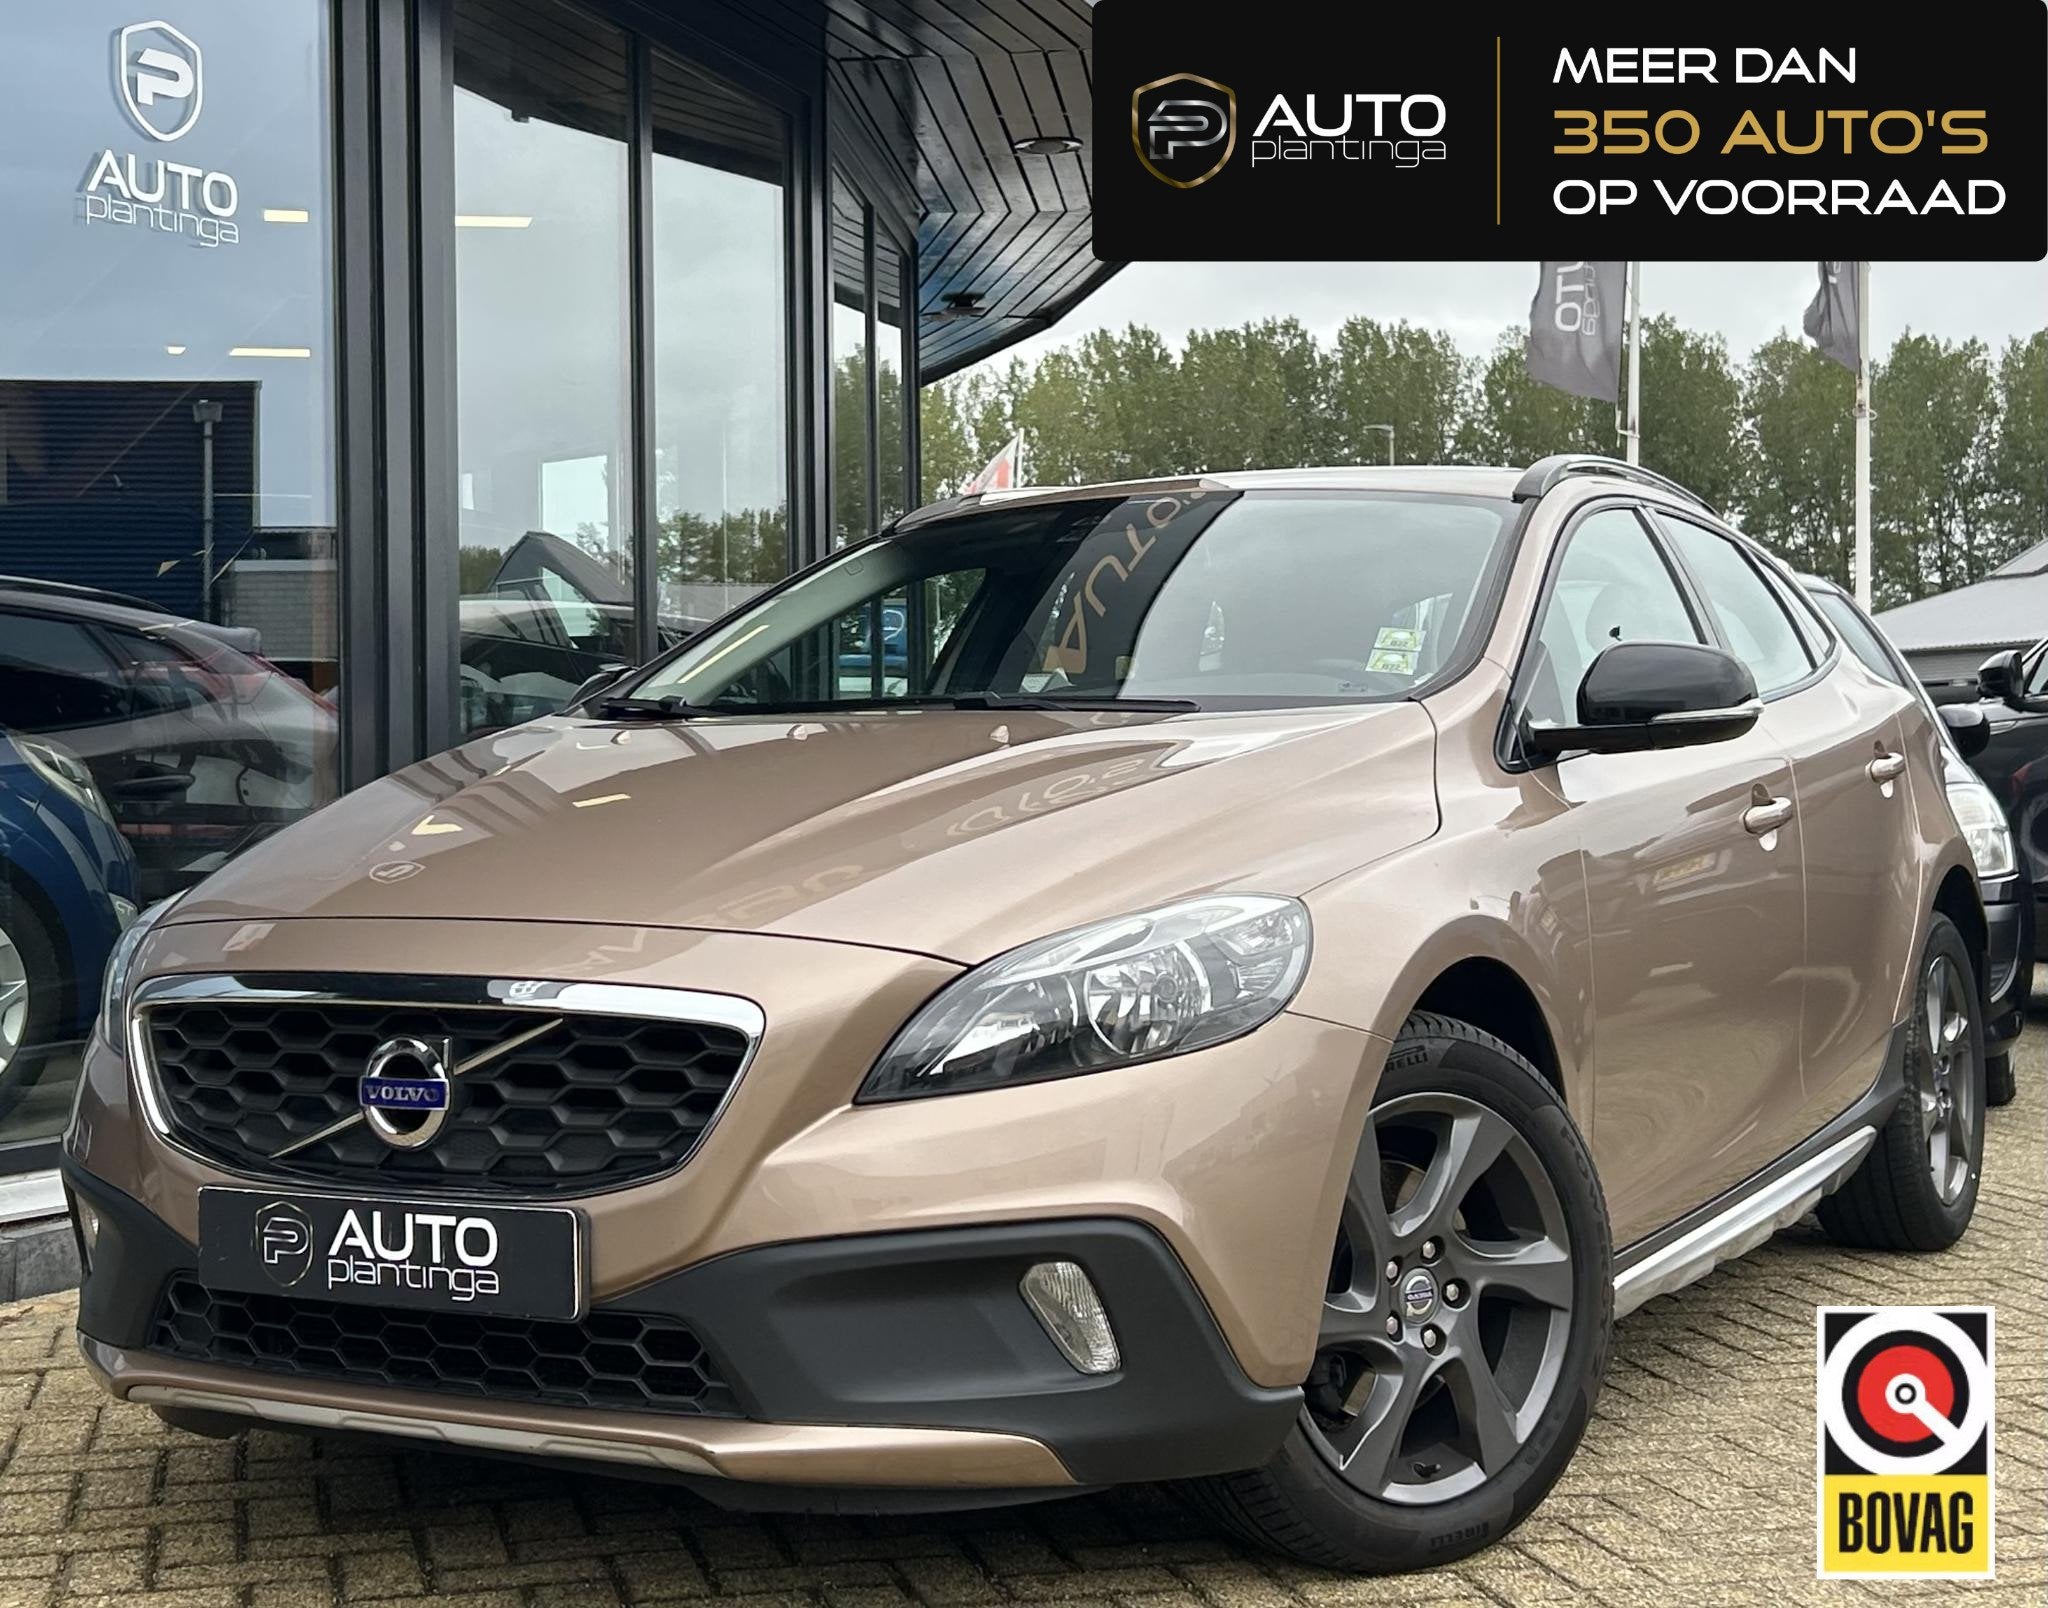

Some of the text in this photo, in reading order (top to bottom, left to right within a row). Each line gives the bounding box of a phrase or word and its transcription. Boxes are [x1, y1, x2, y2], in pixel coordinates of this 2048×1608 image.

[87, 149, 239, 217] AUTO
[86, 193, 240, 248] plantinga
[364, 1084, 440, 1103] VOLVO
[327, 1208, 499, 1267] AUTO
[327, 1255, 500, 1302] plantinga
